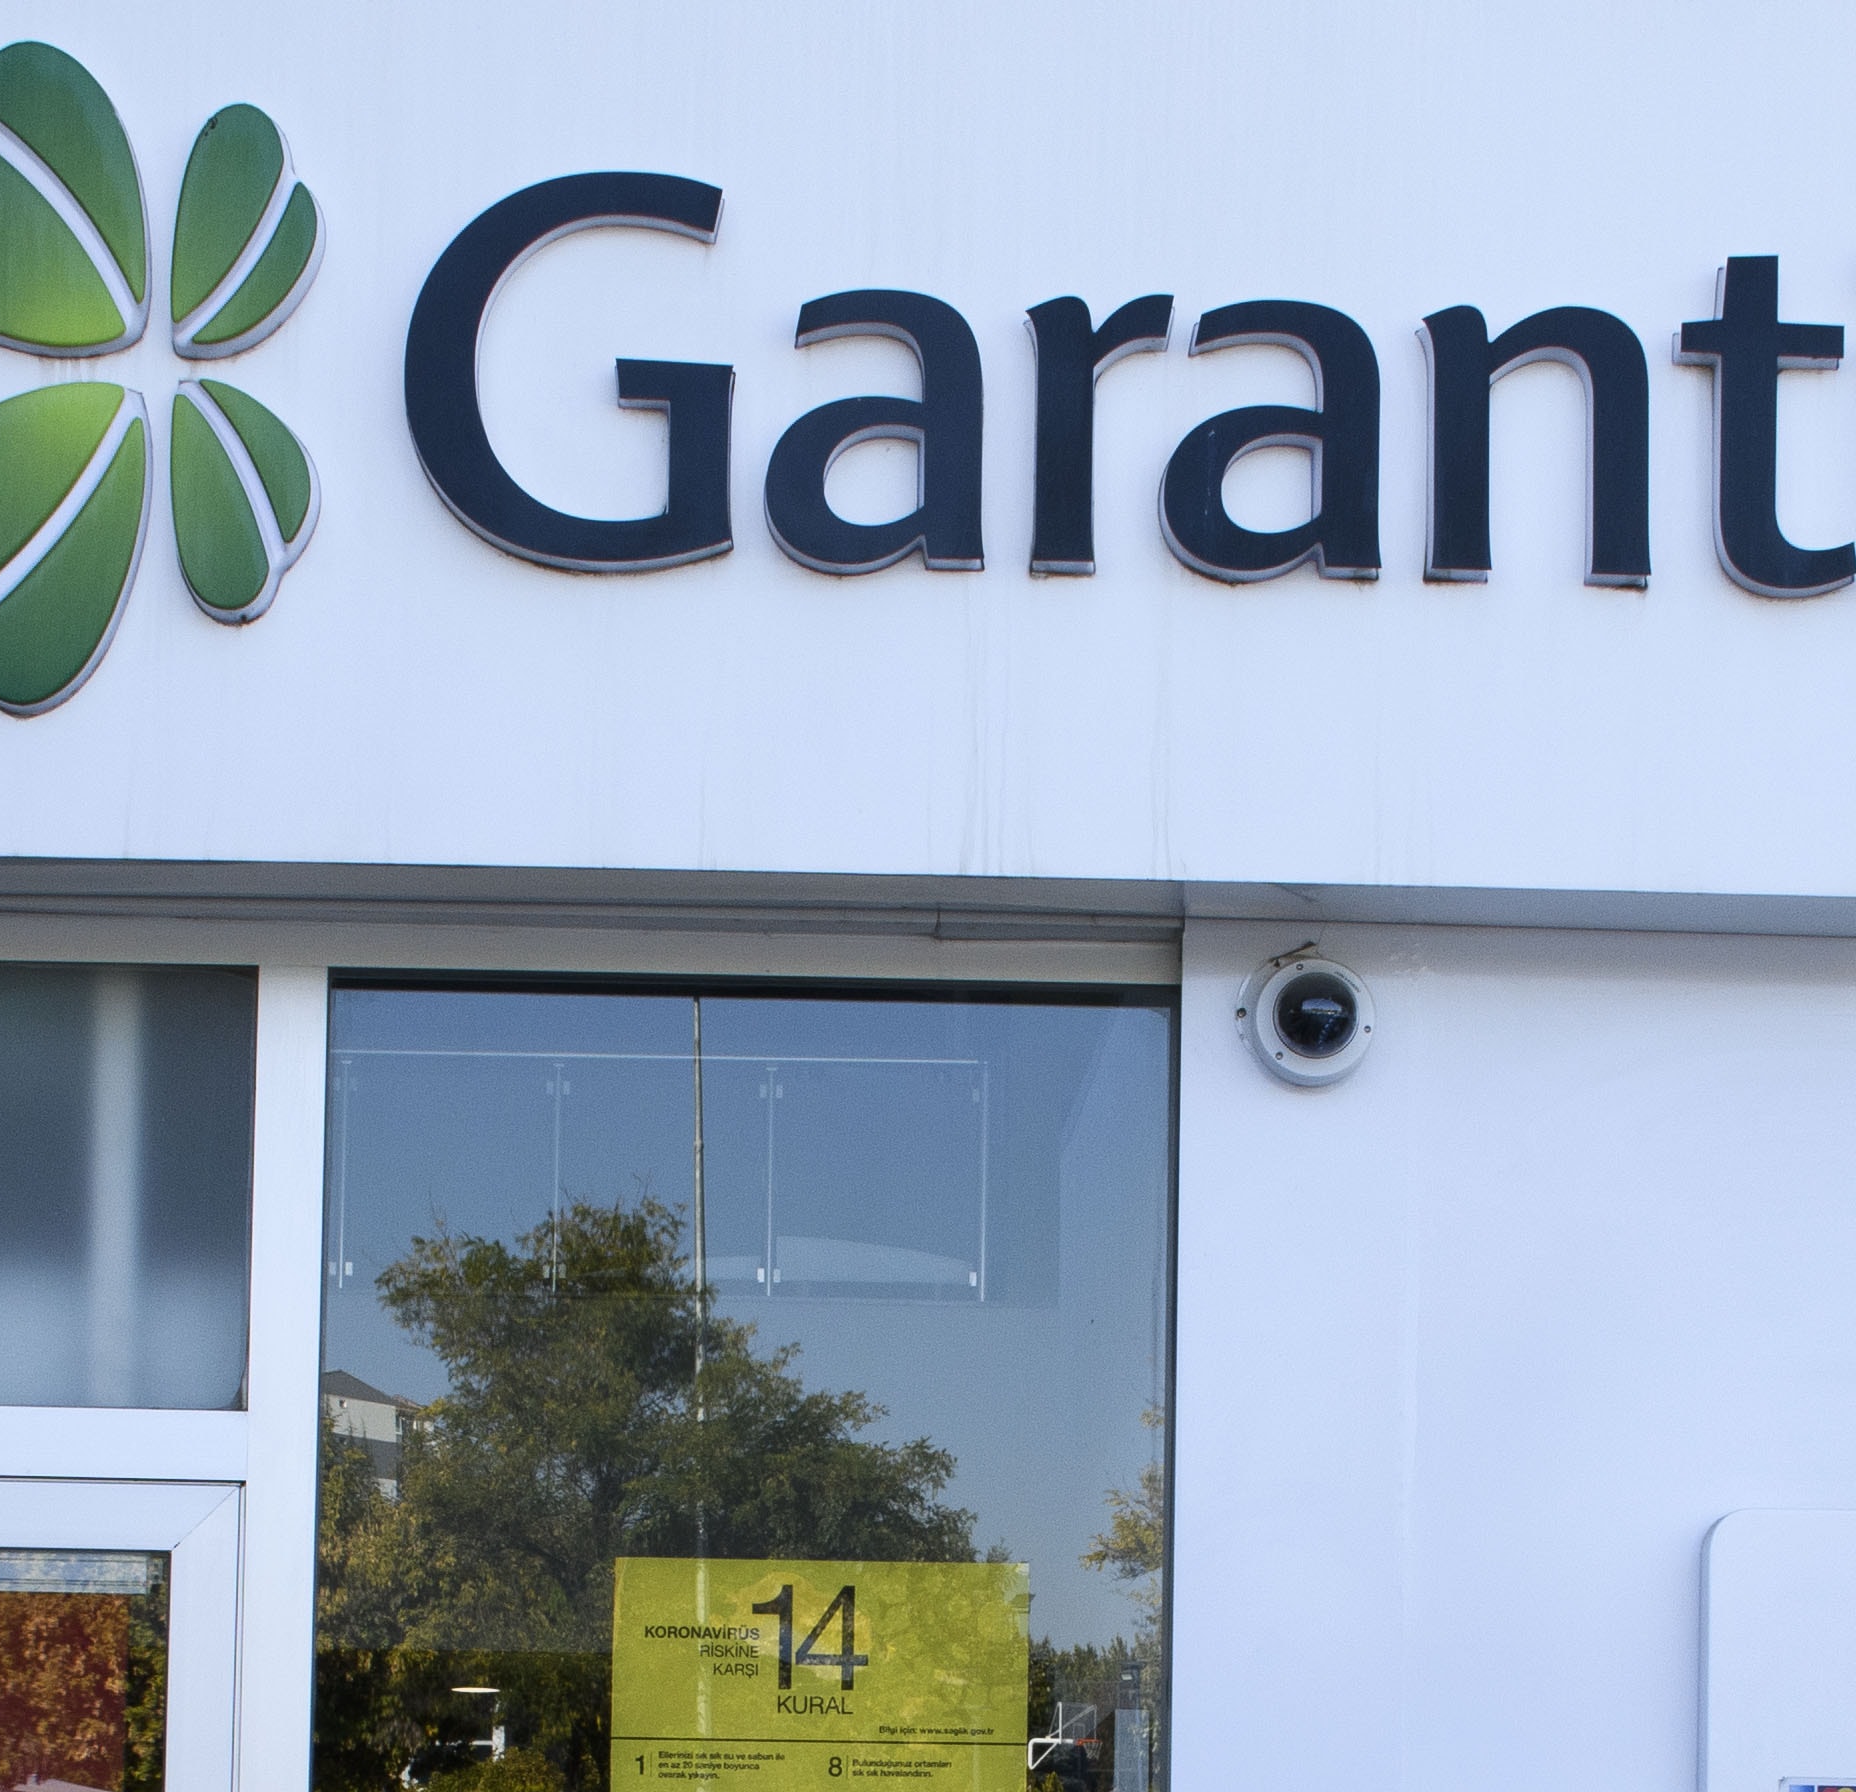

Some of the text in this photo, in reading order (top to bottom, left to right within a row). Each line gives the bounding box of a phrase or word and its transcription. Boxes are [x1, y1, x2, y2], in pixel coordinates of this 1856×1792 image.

[644, 1623, 761, 1641] KORONAVİRÜS
[751, 1583, 869, 1691] 14
[699, 1641, 760, 1659] RİSKİNE
[712, 1662, 759, 1679] KARŞI
[776, 1695, 854, 1715] KURAL
[634, 1754, 644, 1775] 1
[828, 1756, 843, 1778] 8
